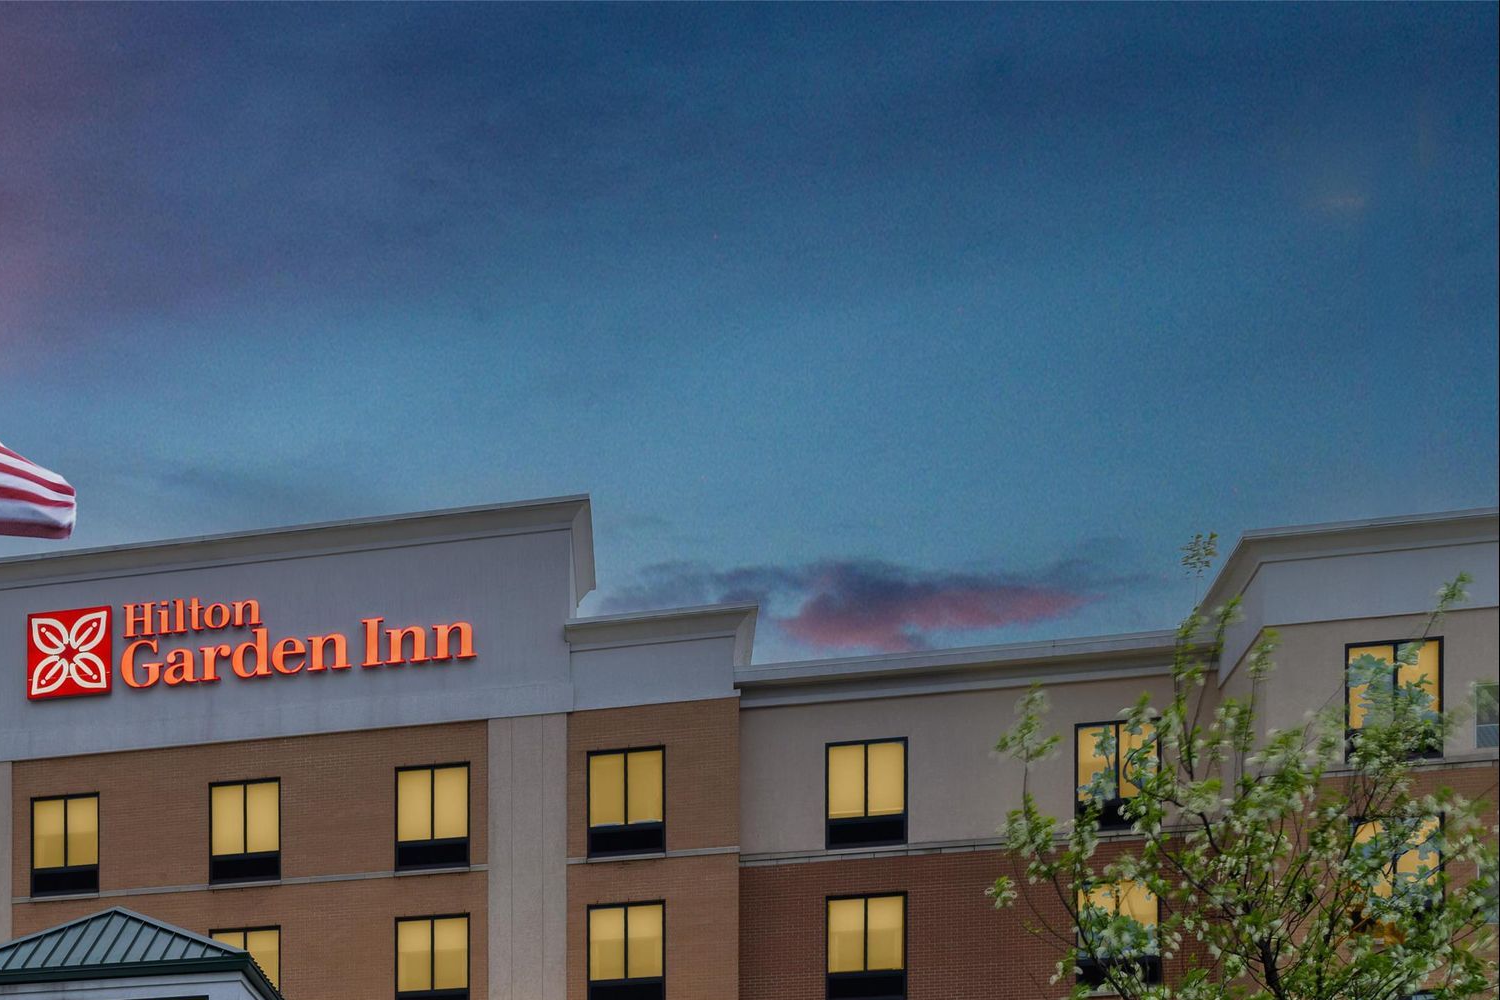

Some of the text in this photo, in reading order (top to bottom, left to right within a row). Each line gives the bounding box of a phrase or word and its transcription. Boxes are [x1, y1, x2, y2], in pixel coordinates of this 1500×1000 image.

[123, 598, 263, 638] Hilton
[121, 617, 477, 688] Garden Inn
